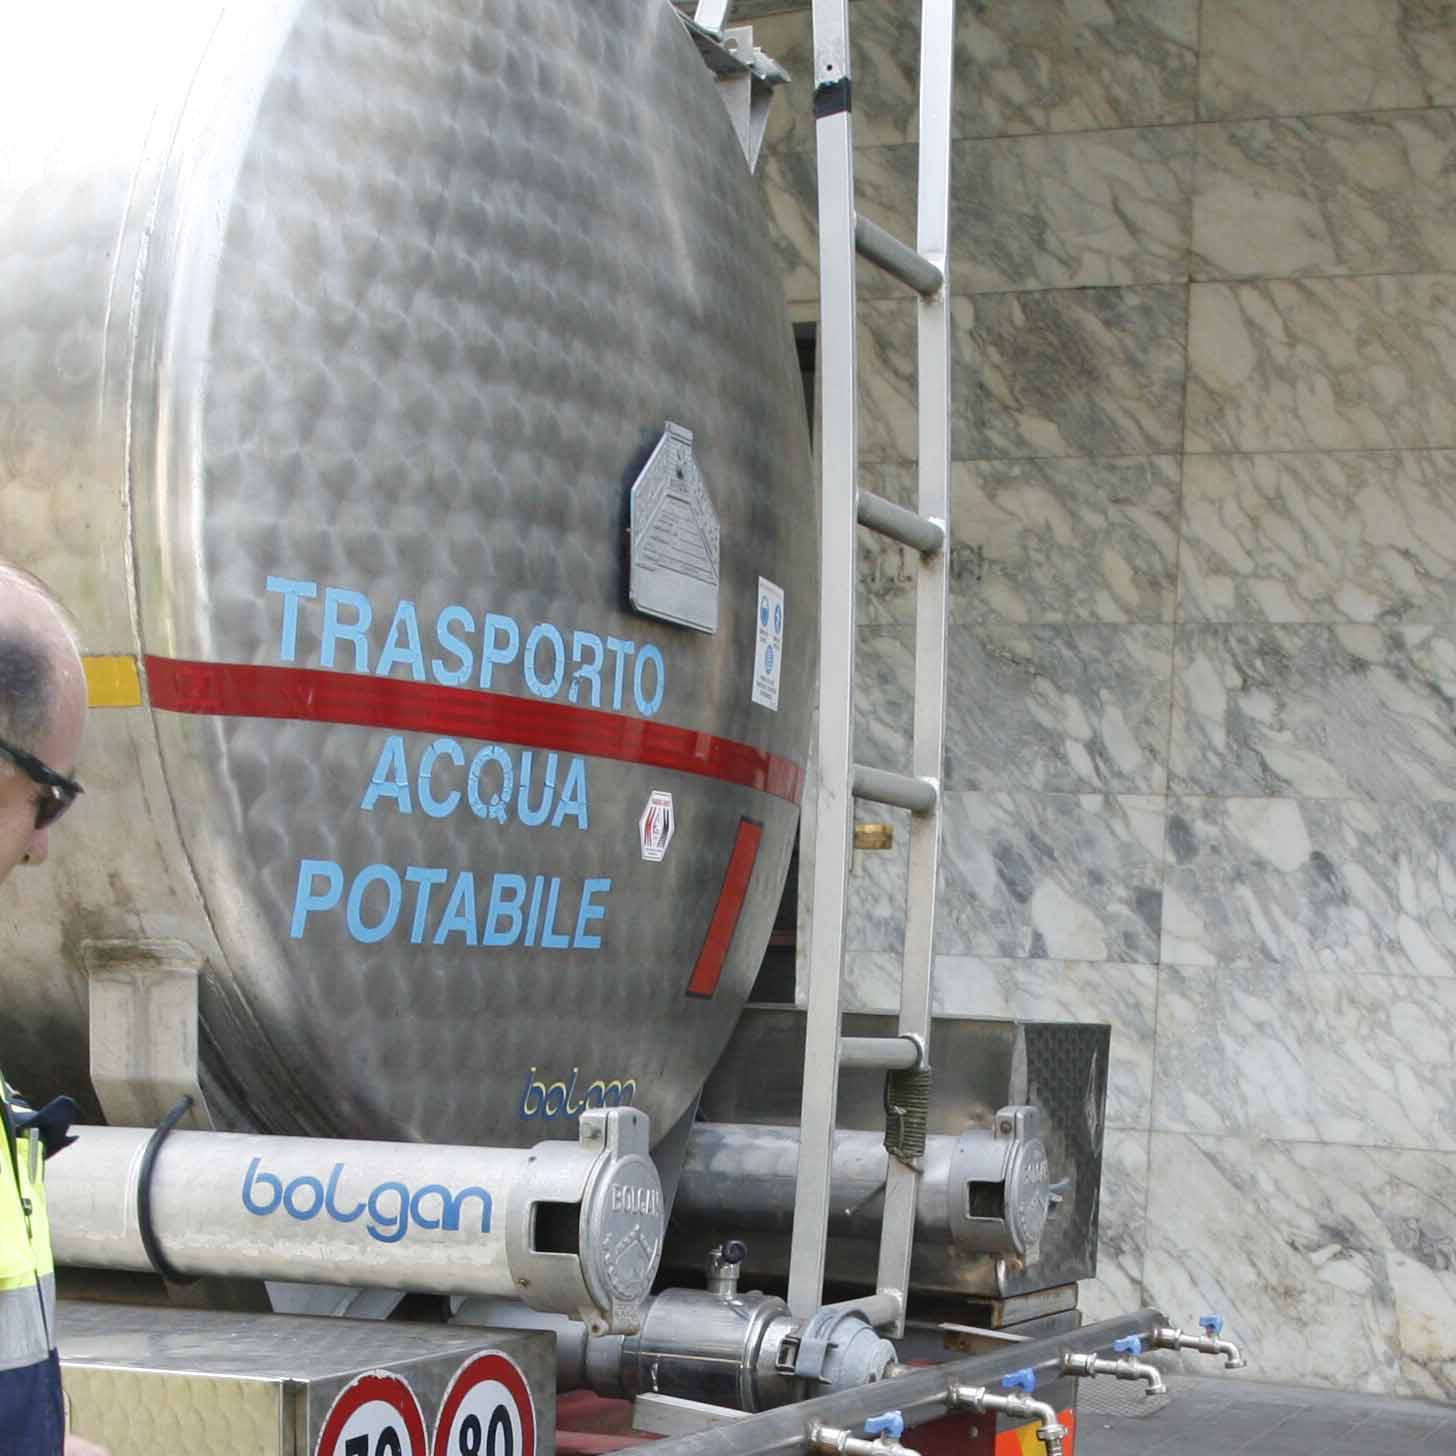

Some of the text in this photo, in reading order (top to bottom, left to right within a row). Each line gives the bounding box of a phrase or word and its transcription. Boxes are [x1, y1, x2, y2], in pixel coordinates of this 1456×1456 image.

[267, 576, 665, 716] TRASPORTO
[361, 735, 589, 830] ACQUA
[290, 859, 611, 949] POTABILE
[243, 1157, 492, 1243] bolgan
